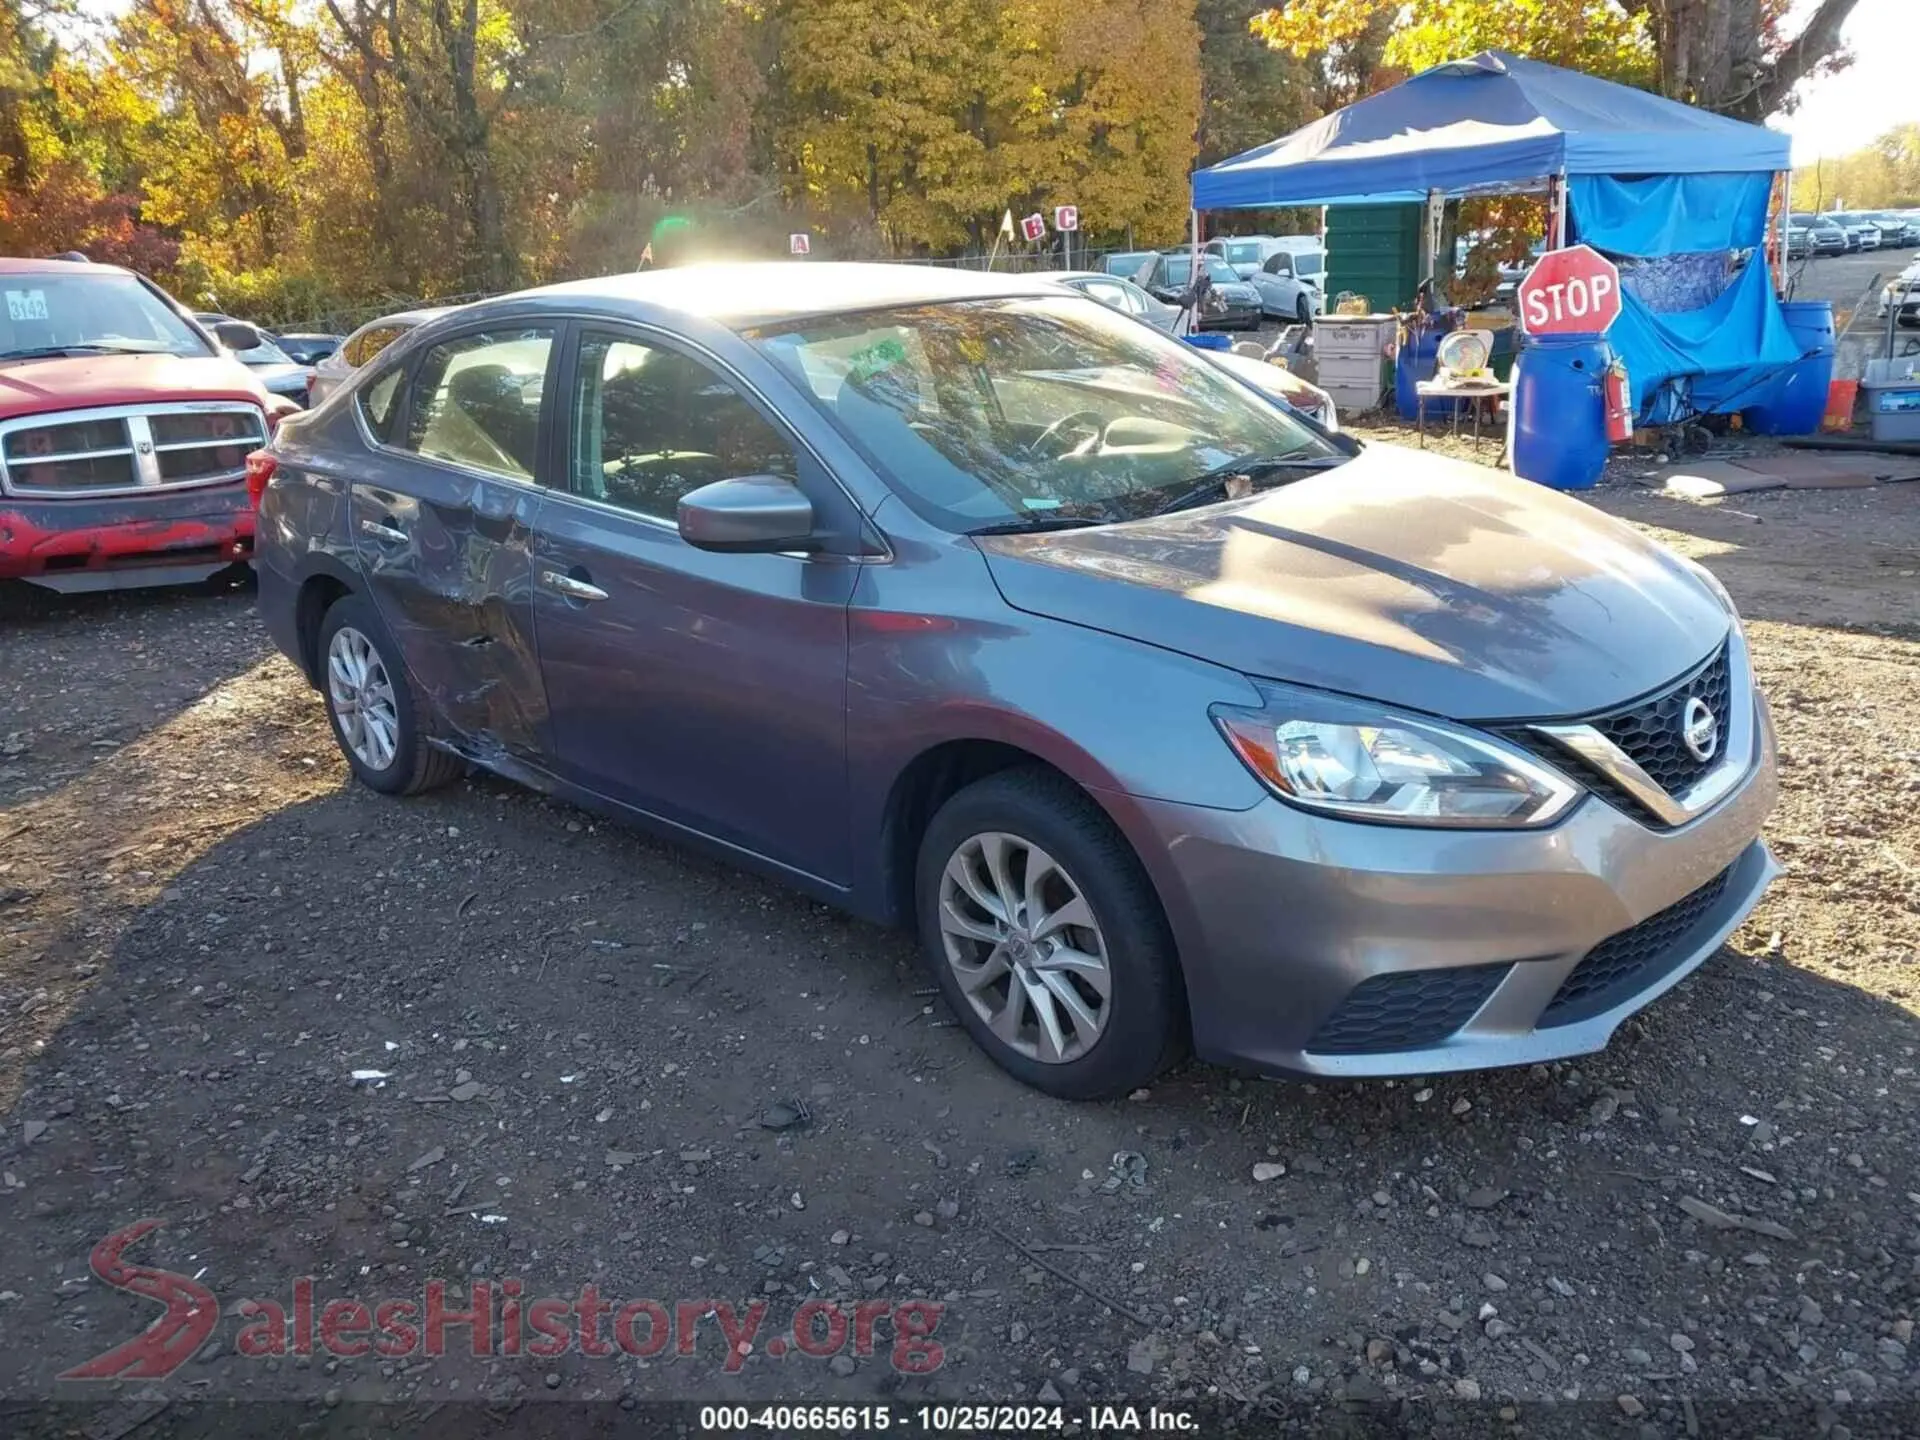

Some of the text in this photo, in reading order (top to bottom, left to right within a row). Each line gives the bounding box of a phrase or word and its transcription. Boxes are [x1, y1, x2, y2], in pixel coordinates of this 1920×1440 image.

[1025, 215, 1043, 240] B
[1059, 207, 1076, 229] C
[793, 235, 808, 252] A
[1527, 274, 1612, 326] STOP
